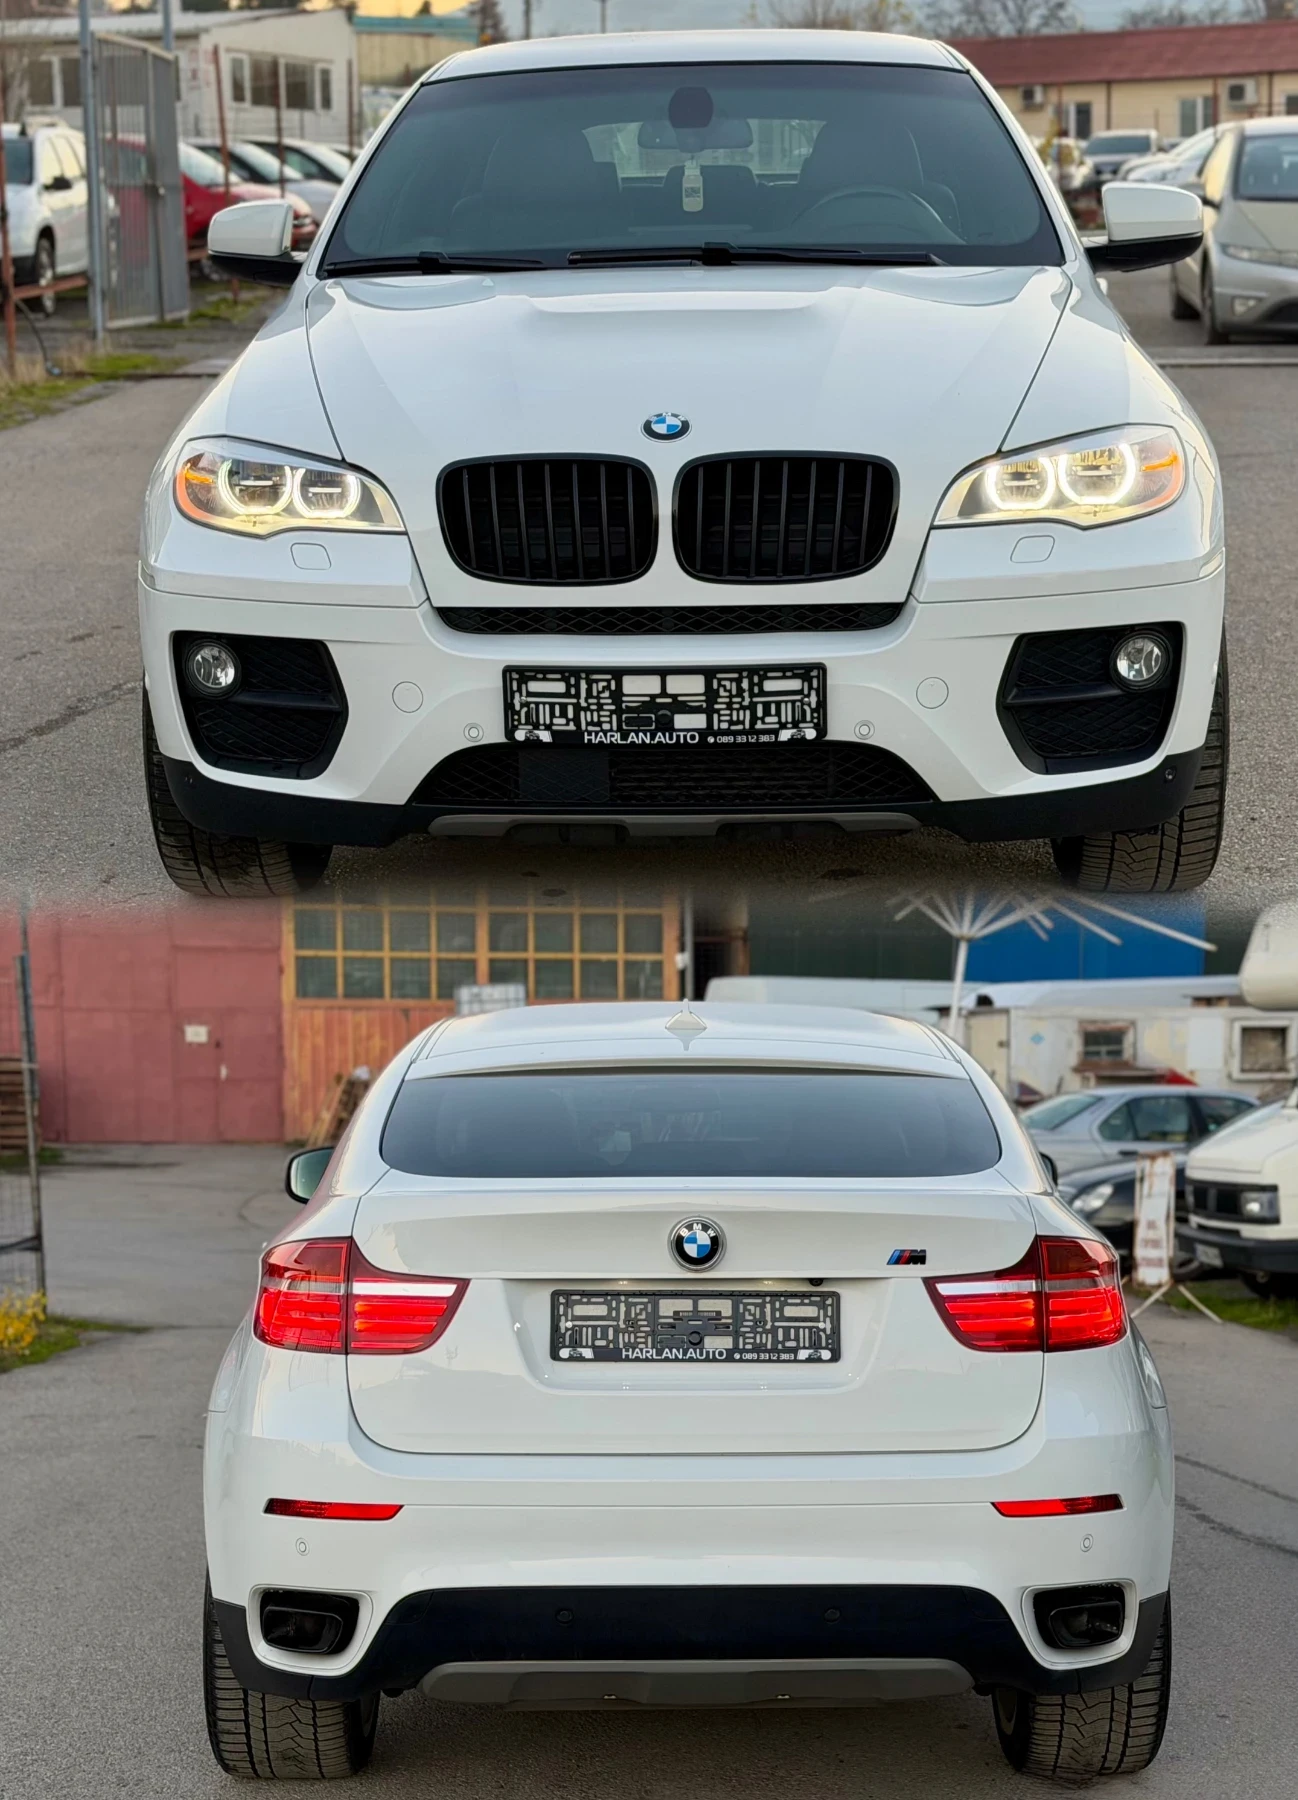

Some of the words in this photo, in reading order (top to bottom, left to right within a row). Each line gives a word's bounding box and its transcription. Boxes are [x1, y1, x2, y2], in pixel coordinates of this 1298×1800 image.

[584, 732, 699, 744] HARLAN.AUTO
[716, 735, 734, 743] 089
[735, 735, 747, 743] 33
[748, 735, 757, 743] 12
[758, 734, 775, 742] 383
[679, 1222, 716, 1237] BMW
[622, 1348, 727, 1359] HARLAN.AUTO
